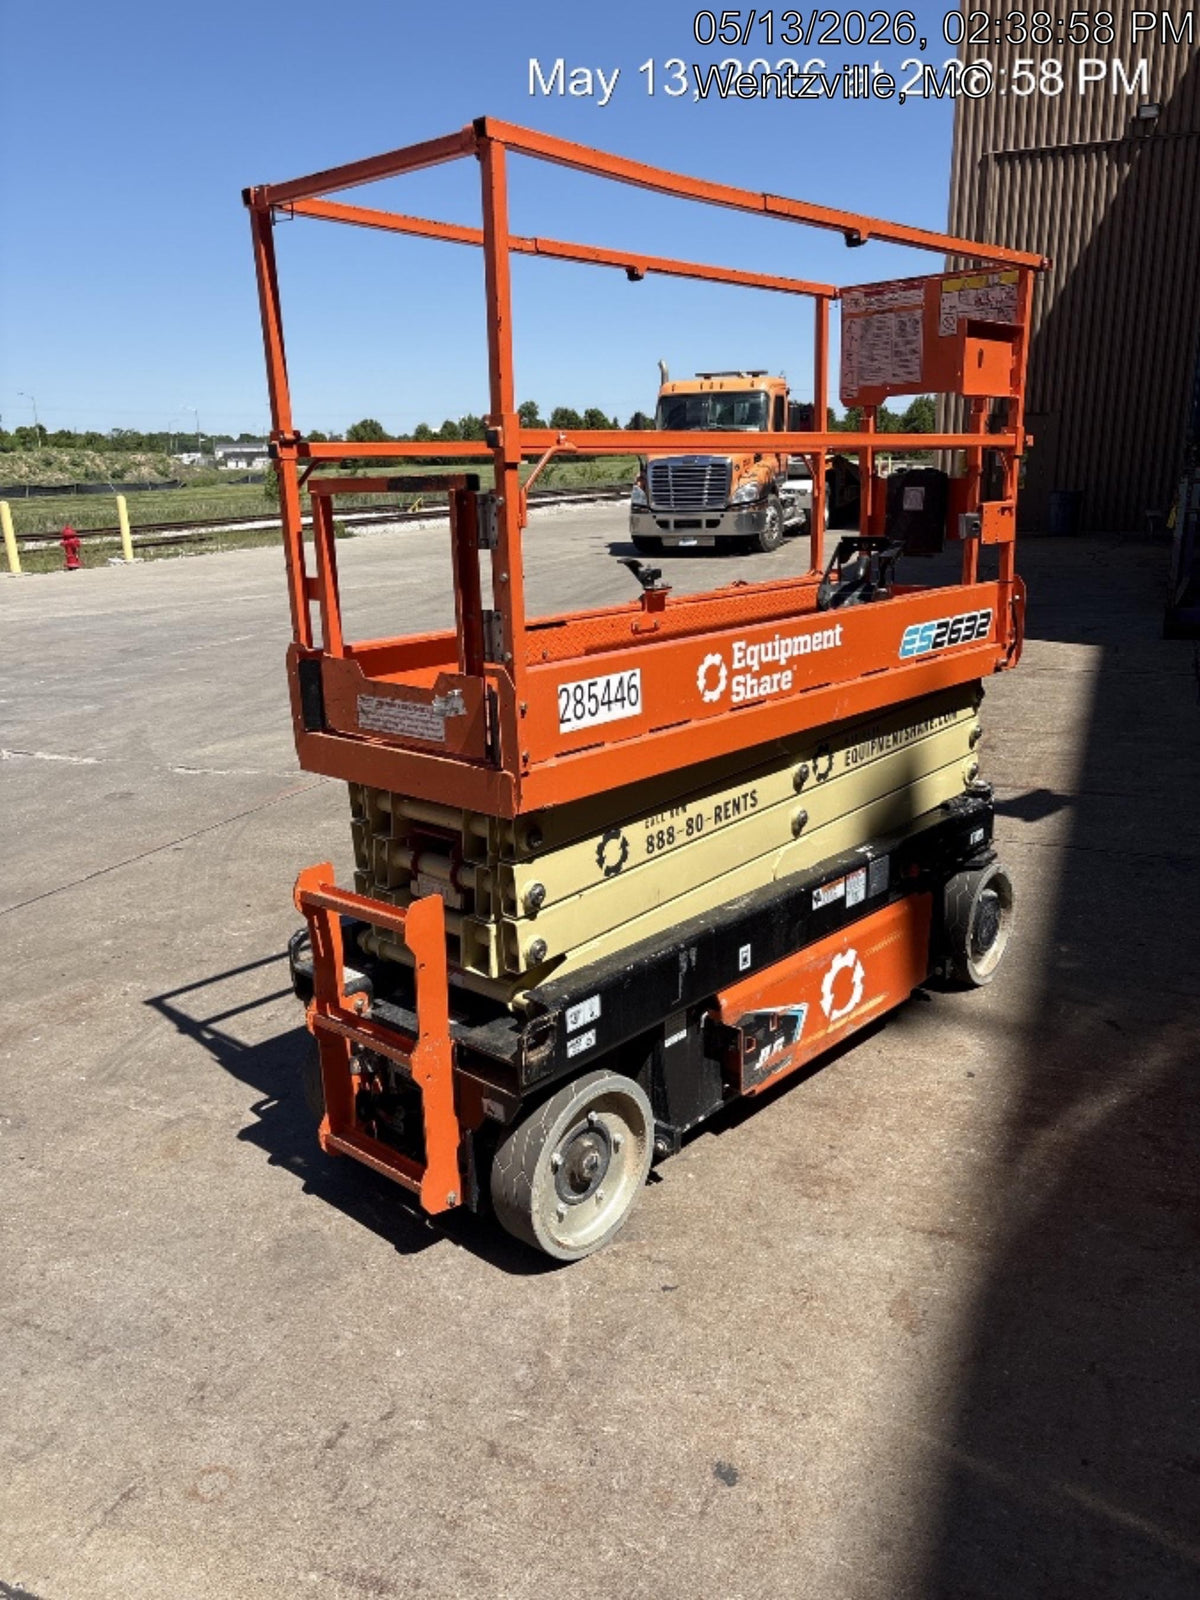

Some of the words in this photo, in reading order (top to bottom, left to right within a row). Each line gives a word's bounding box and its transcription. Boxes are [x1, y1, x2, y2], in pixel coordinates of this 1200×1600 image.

[732, 624, 842, 671] Equipment
[900, 610, 992, 658] ES2632
[559, 671, 640, 724] 285446
[731, 669, 792, 703] Share
[646, 789, 758, 854] 888-80-RENTS
